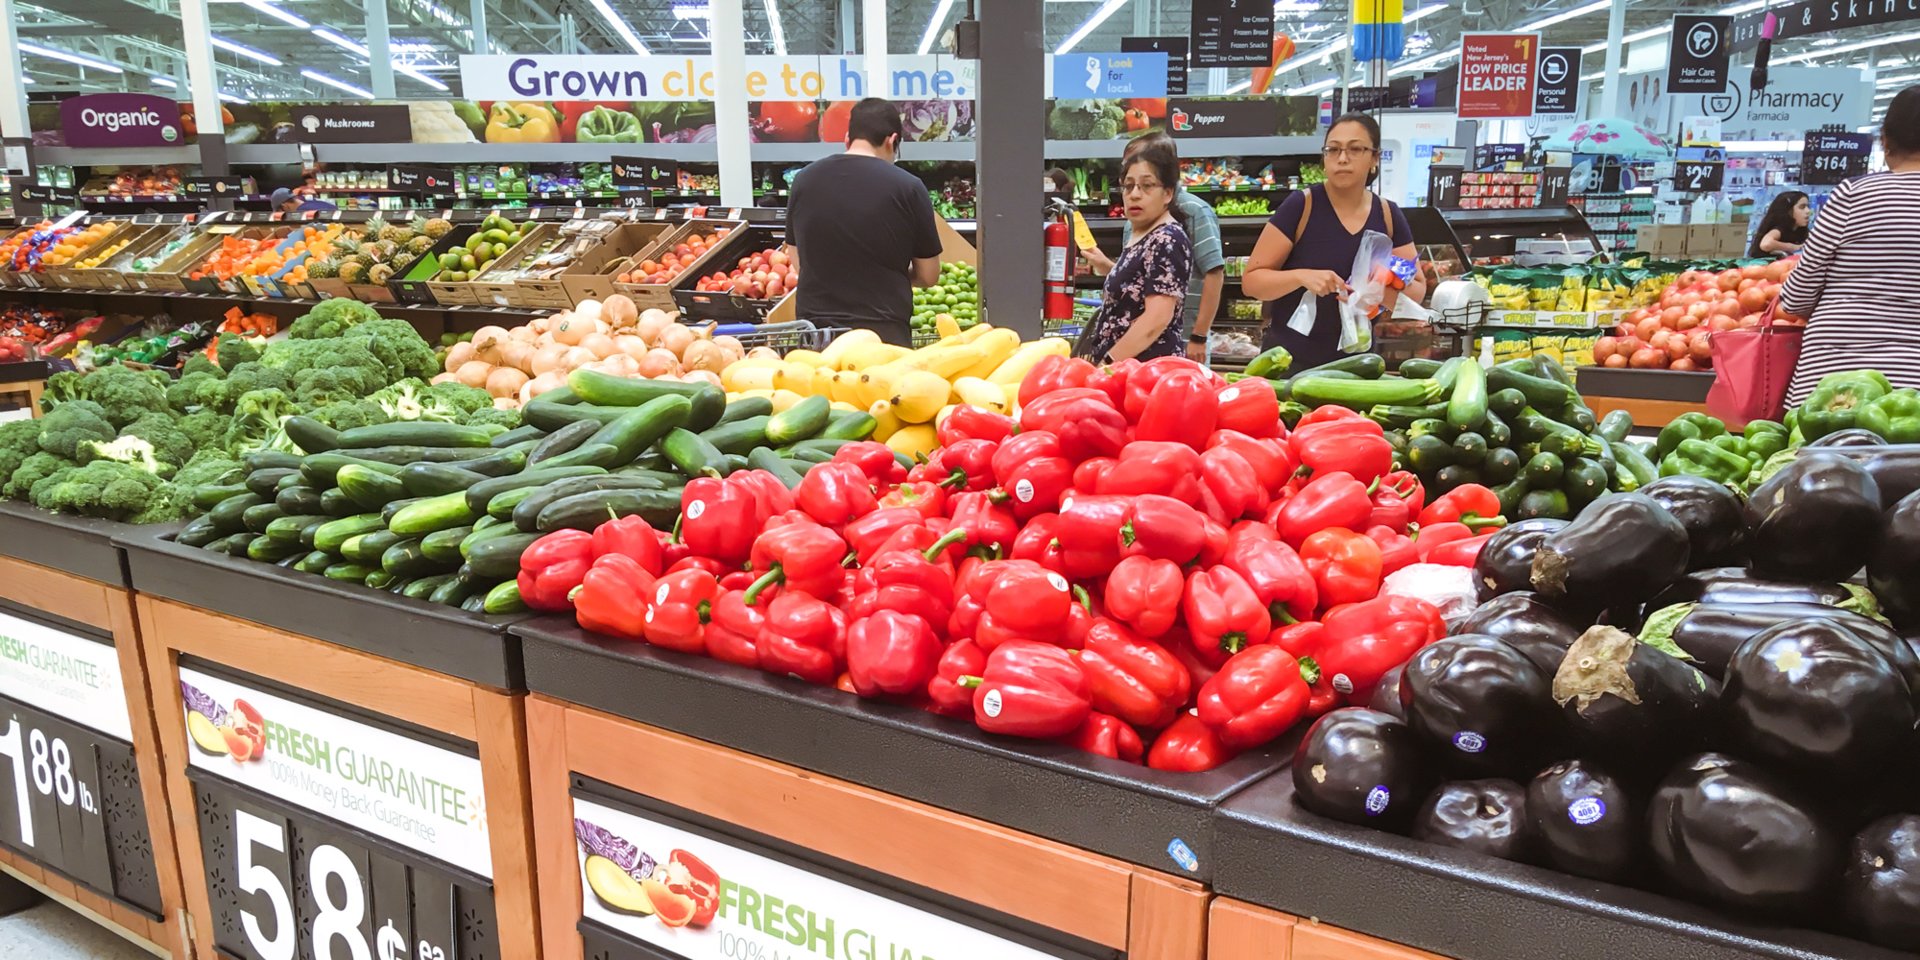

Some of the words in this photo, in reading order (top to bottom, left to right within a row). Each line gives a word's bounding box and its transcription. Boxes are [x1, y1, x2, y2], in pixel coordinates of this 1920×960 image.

[1230, 0, 1237, 8] 2
[1734, 17, 1786, 43] Beauy
[1802, 7, 1811, 26] &
[1830, 0, 1895, 21] Skin
[1467, 45, 1488, 53] Voted
[1514, 39, 1530, 60] #1
[1107, 57, 1133, 68] Look
[1466, 54, 1481, 62] New
[1483, 54, 1509, 62] Jersey's
[1465, 64, 1491, 75] LOW
[1494, 63, 1527, 74] PRICE
[1681, 67, 1697, 76] Hair
[1698, 67, 1716, 76] Care
[509, 58, 647, 97] Grown
[662, 59, 767, 97] cloe
[781, 63, 825, 97] to
[839, 59, 966, 97] hme.
[1108, 70, 1125, 81] for
[1106, 83, 1135, 94] local.
[1463, 76, 1527, 91] LEADER
[1538, 88, 1566, 96] Personal
[1544, 95, 1559, 103] Care
[1748, 89, 1844, 112] Pharmacy
[81, 106, 160, 132] Organic
[1193, 113, 1225, 125] Peppers
[1747, 111, 1790, 121] Farmacia
[324, 118, 376, 128] Mushrooms
[1821, 140, 1838, 150] Low
[1838, 140, 1859, 150] Price
[1815, 155, 1848, 170] $164
[1686, 165, 1714, 189] $247
[29, 644, 99, 688] GUARANTEE
[264, 719, 331, 773] FRESH
[336, 747, 467, 825] GUARANTEE
[79, 780, 98, 815] lb.
[268, 758, 299, 787] 100%
[301, 771, 338, 808] Money
[341, 787, 372, 816] Back
[374, 799, 436, 843] Guarantee
[718, 877, 835, 960] FRESH
